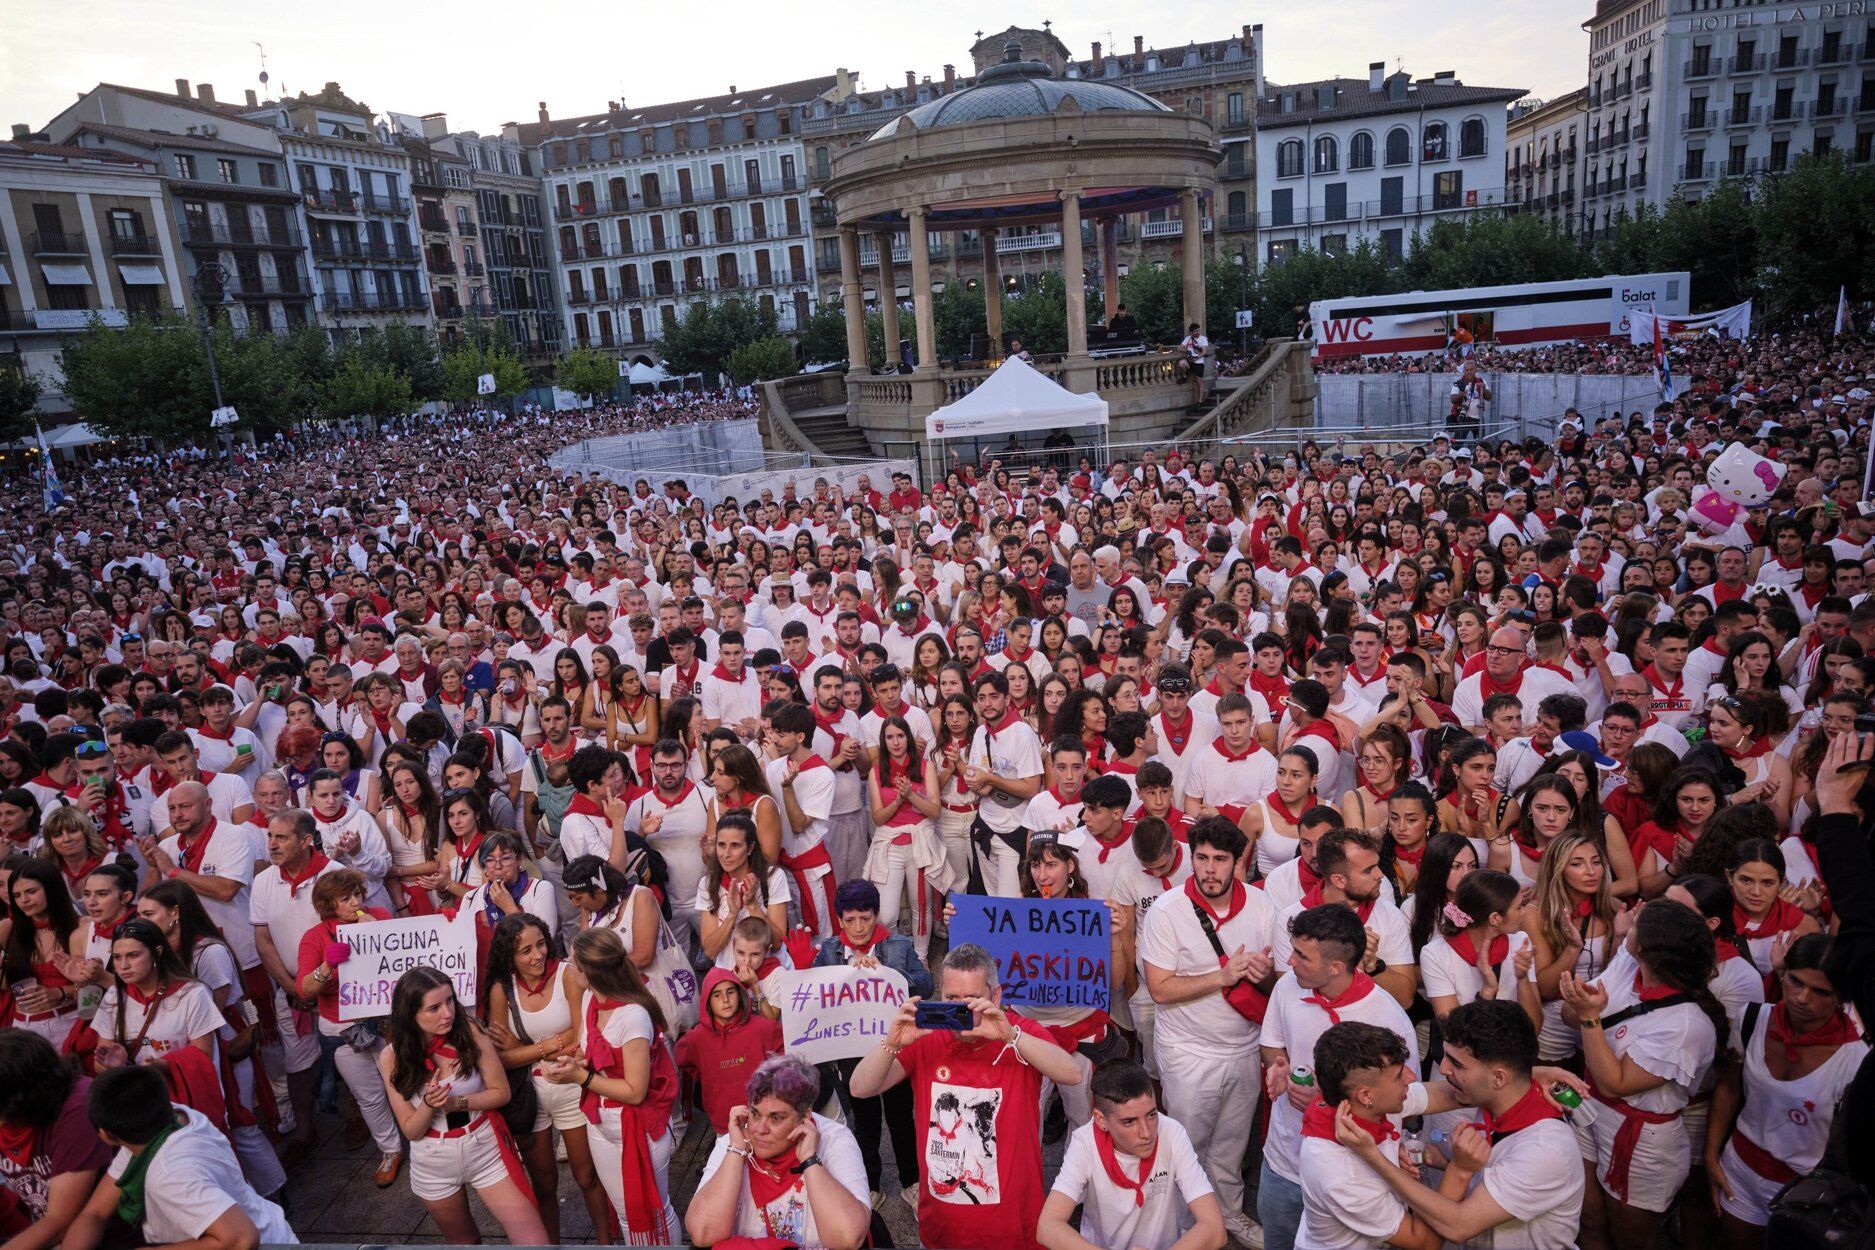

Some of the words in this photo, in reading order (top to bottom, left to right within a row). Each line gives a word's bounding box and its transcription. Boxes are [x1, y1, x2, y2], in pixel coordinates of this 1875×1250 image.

[1688, 12, 1761, 32] HOTEL
[1773, 8, 1806, 24] LA
[1817, 1, 1875, 18] PERL
[1592, 48, 1616, 69] GRAN
[1624, 30, 1656, 54] HOTEL
[1621, 288, 1656, 303] balat
[1322, 316, 1374, 343] WC
[982, 906, 1017, 934] YA
[1028, 908, 1103, 937] BASTA
[790, 1017, 888, 1046] LUNES-LIL
[931, 1139, 943, 1150] 2023
